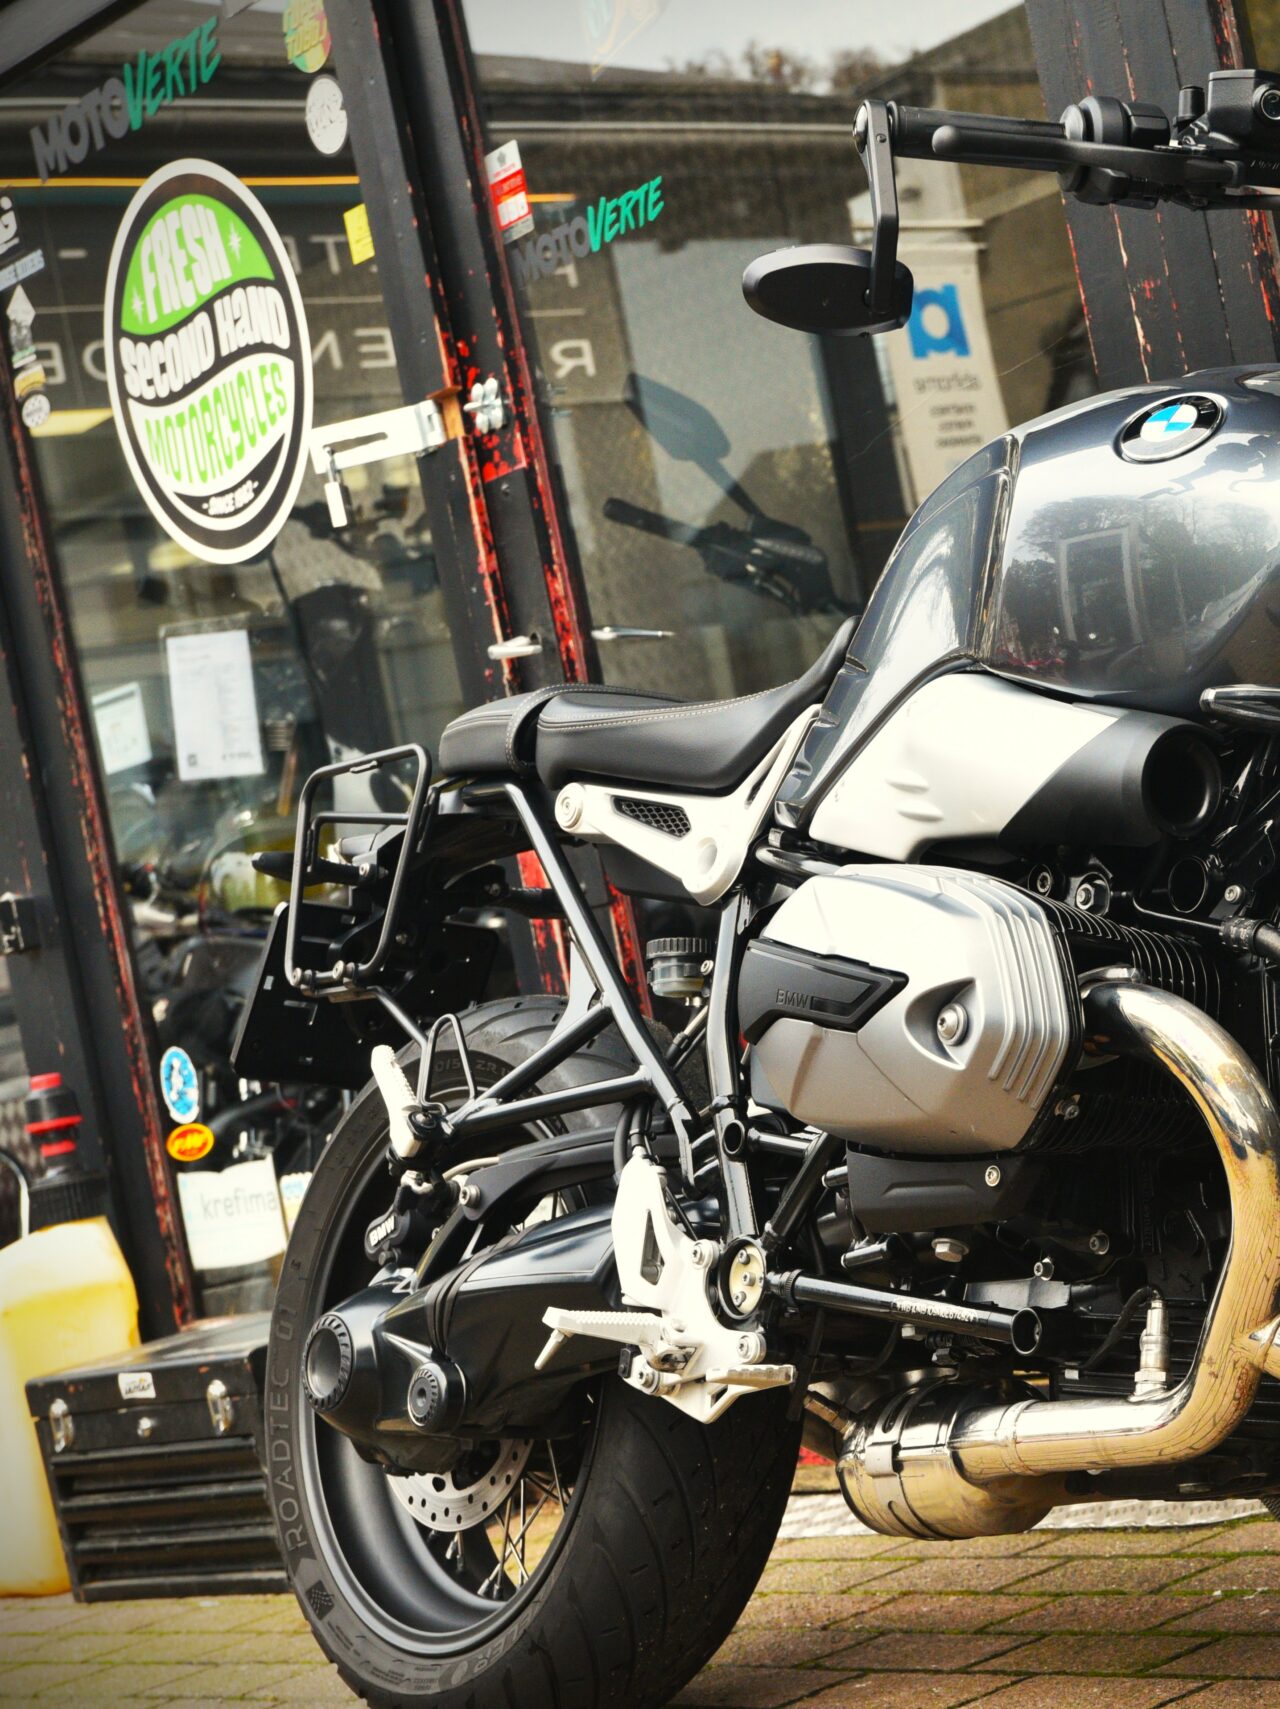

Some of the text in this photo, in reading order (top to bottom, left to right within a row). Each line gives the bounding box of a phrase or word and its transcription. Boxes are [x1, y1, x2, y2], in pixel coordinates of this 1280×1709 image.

[140, 204, 232, 324] FRESH
[145, 361, 287, 484] MOTORCYCLES
[775, 988, 809, 1009] BMW
[369, 1215, 395, 1247] BMW
[269, 1365, 306, 1552] ROADTEC
